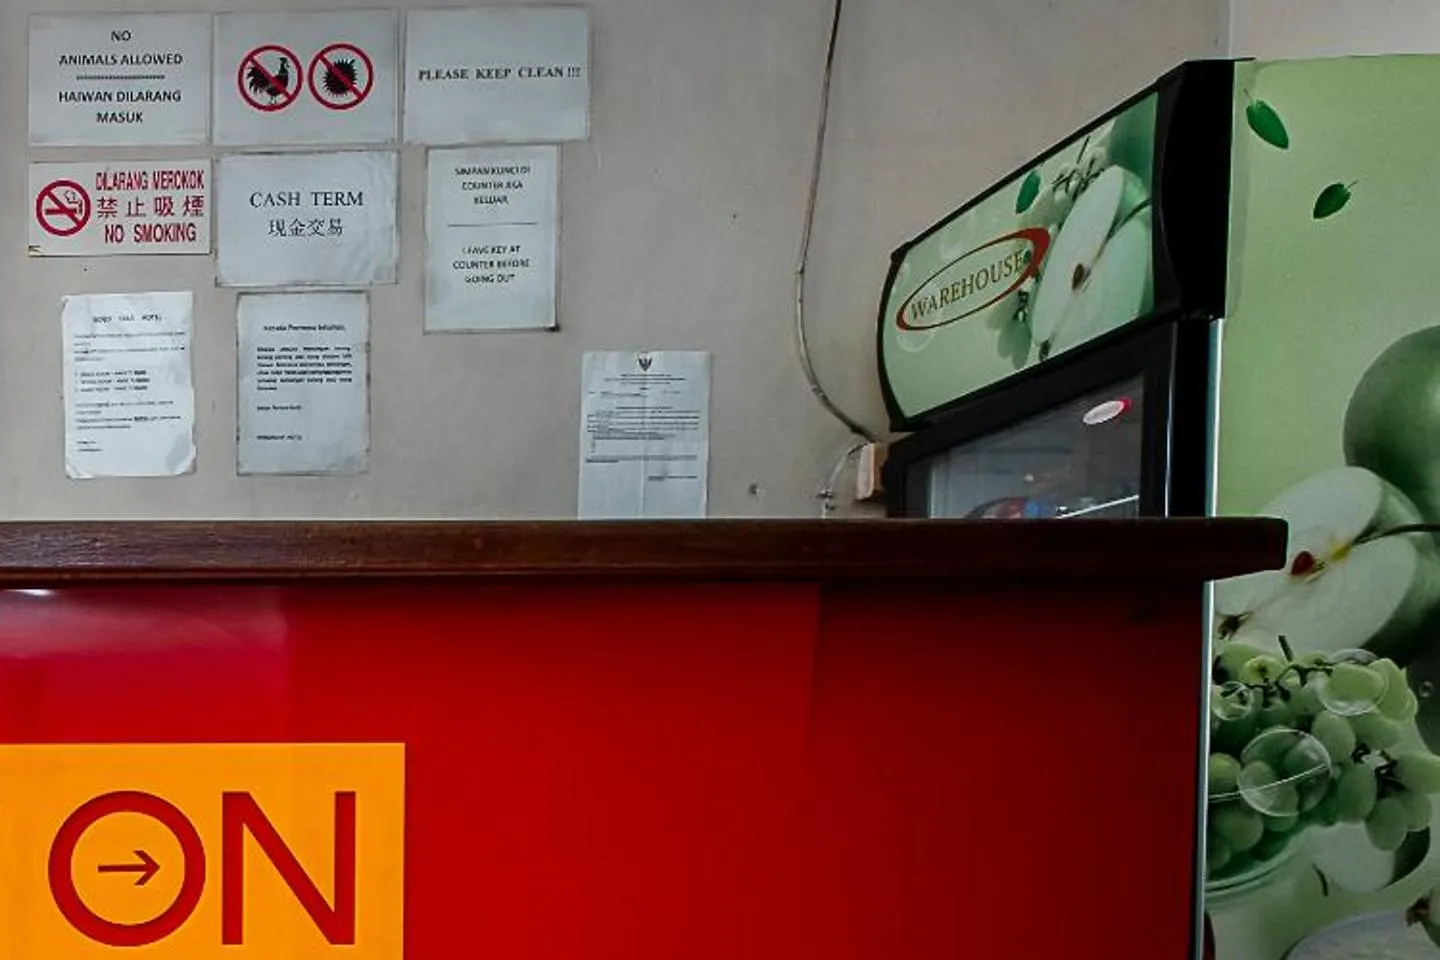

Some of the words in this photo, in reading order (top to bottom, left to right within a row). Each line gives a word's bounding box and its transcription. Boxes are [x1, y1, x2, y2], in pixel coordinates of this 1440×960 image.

[110, 30, 132, 42] NO
[59, 54, 118, 66] ANIMALS
[120, 53, 183, 65] ALLOWED
[418, 68, 469, 81] PLEASE
[475, 68, 511, 80] KEEP
[517, 66, 564, 78] CLEAN
[58, 91, 113, 102] HAIWAN
[116, 90, 182, 102] DILARANG
[96, 112, 143, 123] MASUK
[95, 170, 149, 191] DILARANG
[152, 169, 205, 190] MEROKOK
[462, 181, 504, 190] COUNTER
[97, 195, 205, 218] 禁止吸煙
[249, 191, 301, 208] CASH
[310, 191, 364, 207] TERM
[105, 224, 124, 243] NO
[133, 222, 197, 243] SMOKING
[268, 218, 343, 237] 現金交易
[490, 245, 507, 254] KEY
[509, 245, 521, 253] AT
[452, 260, 494, 270] COUNTER
[496, 258, 530, 268] BEFORE
[464, 273, 495, 283] GOING
[496, 273, 516, 283] OUT
[910, 249, 1024, 320] WAREHOUSE
[47, 789, 357, 948] ON
